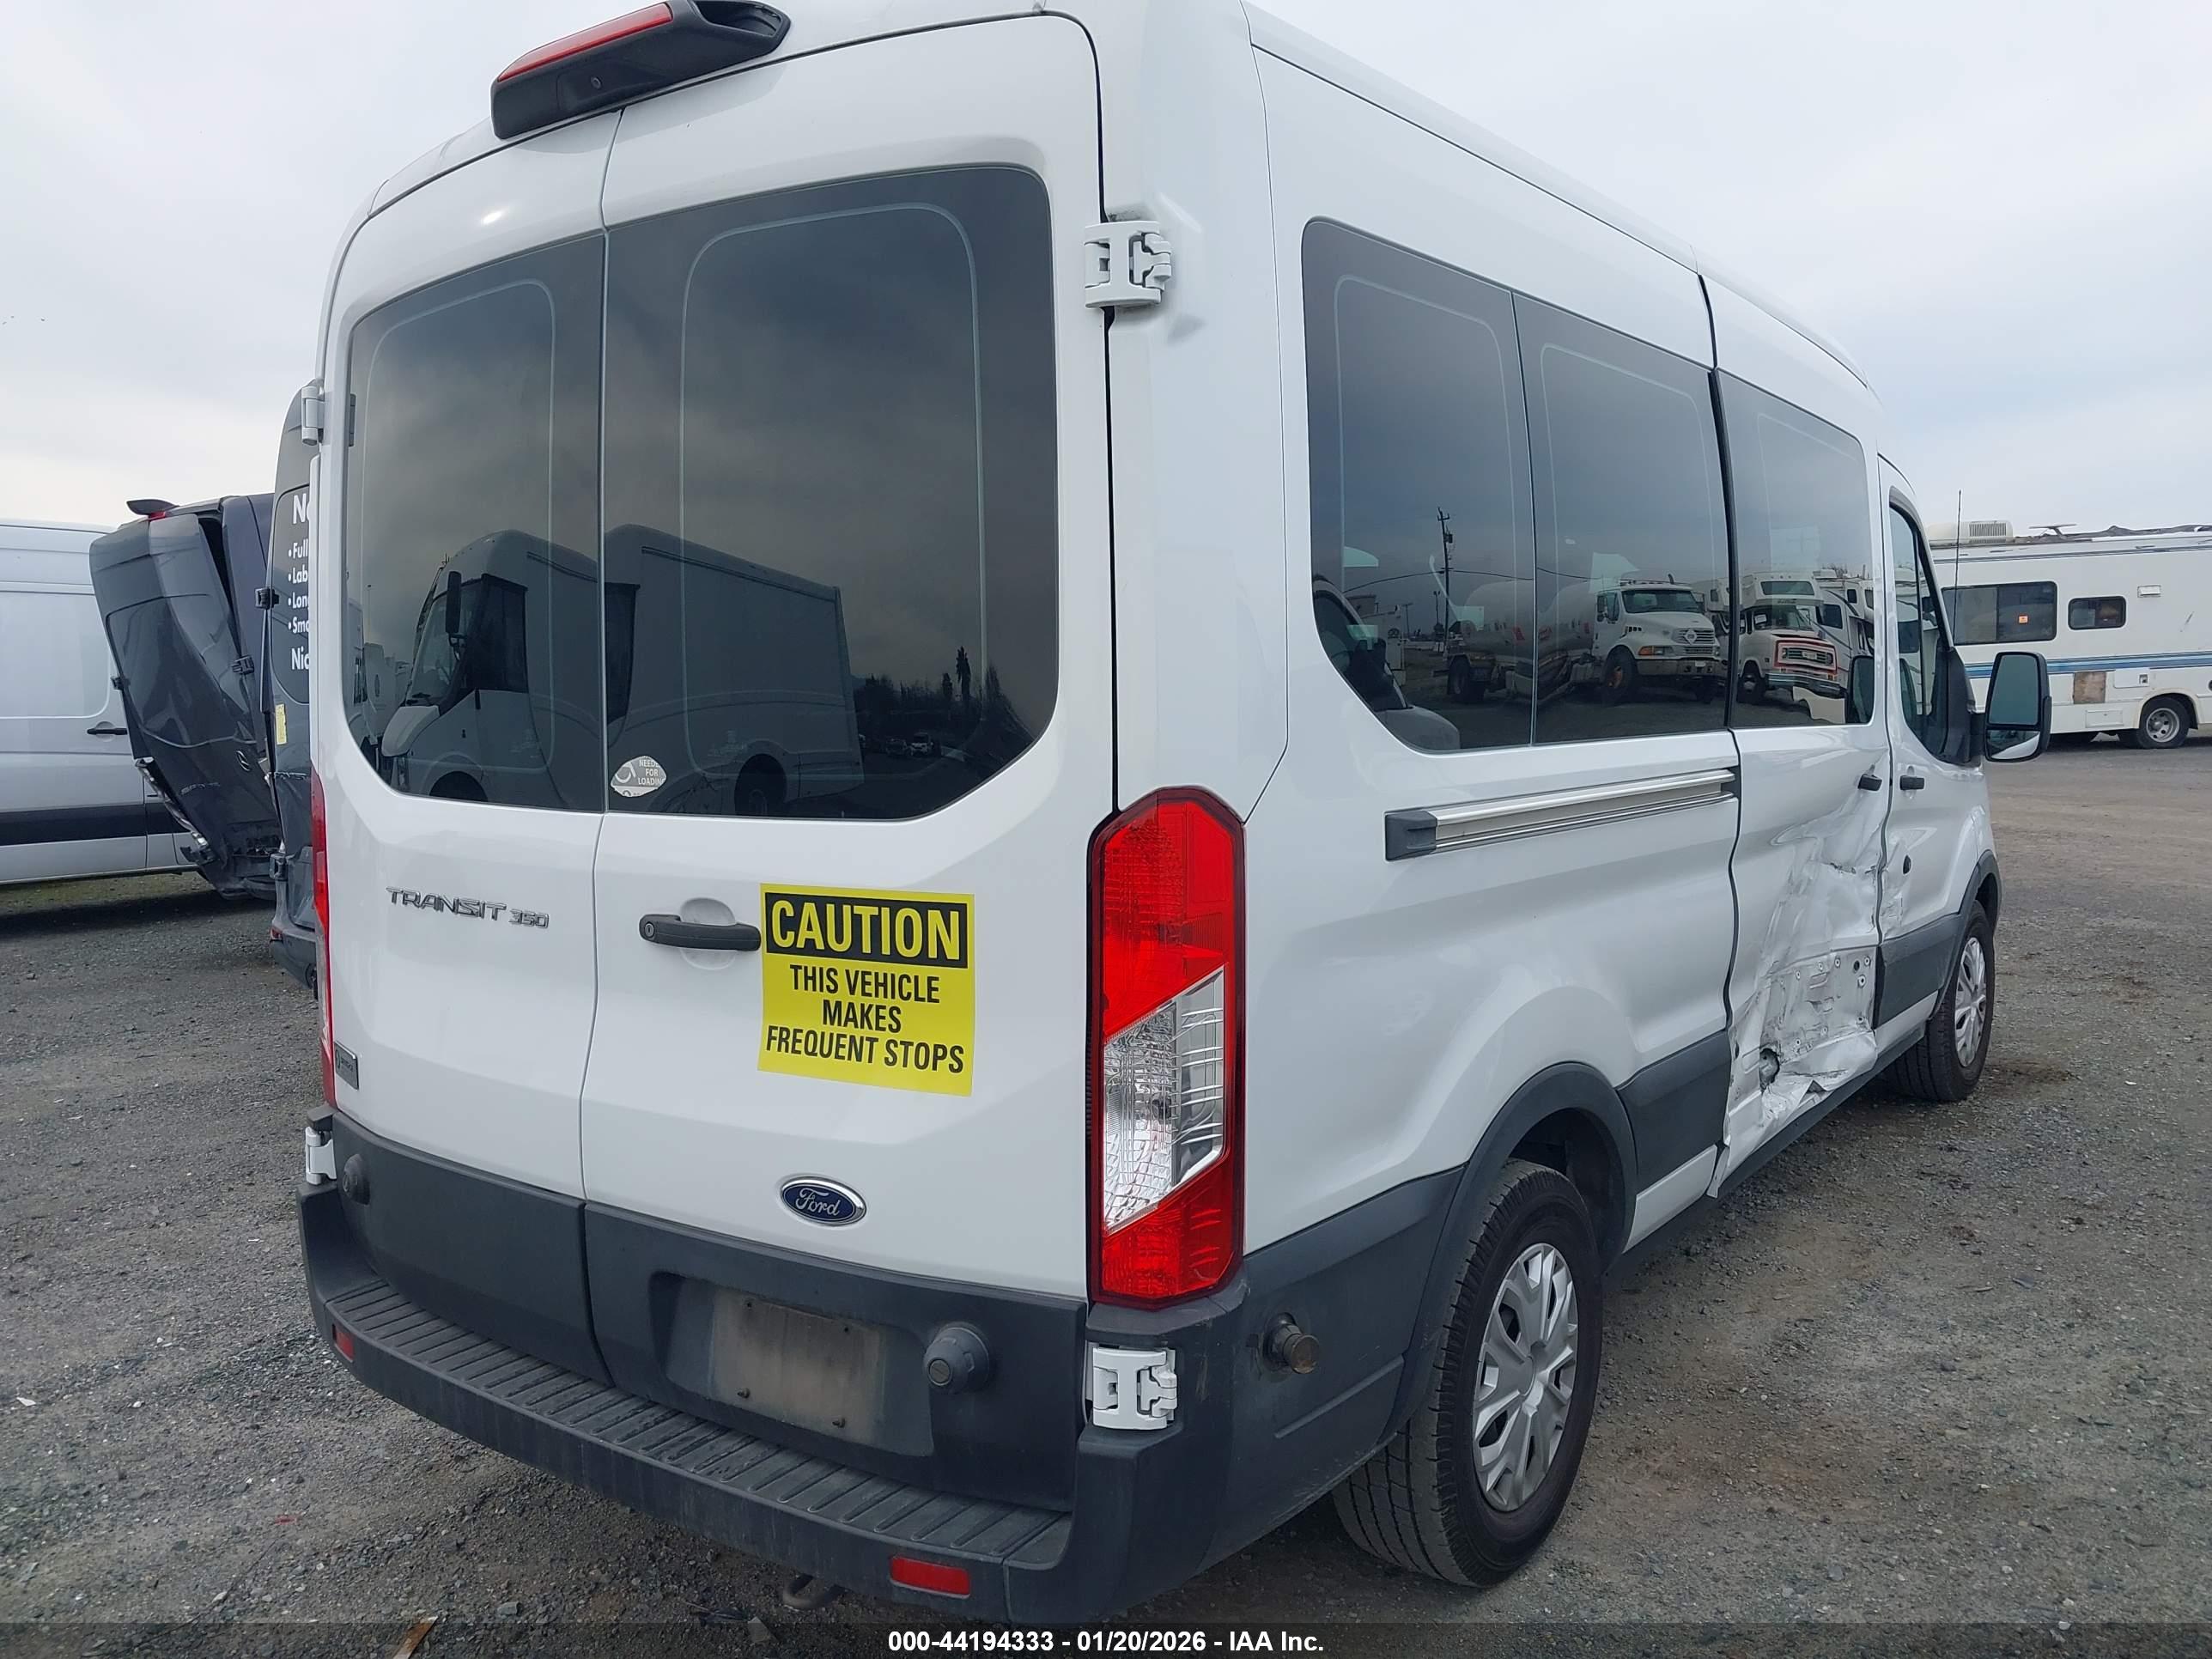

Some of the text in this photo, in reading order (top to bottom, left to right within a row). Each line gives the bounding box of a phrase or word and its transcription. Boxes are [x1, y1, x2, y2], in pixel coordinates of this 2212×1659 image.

[293, 538, 308, 559] Full
[293, 564, 308, 584] Lab
[293, 592, 309, 610] Lon
[386, 886, 550, 929] TRANSIT 350
[771, 899, 961, 961] CAUTION
[789, 963, 940, 1004] THIS VEHICLE
[822, 999, 902, 1034] MAKES
[766, 1024, 964, 1074] FREQUENT STOPS
[795, 1188, 842, 1216] Ford
